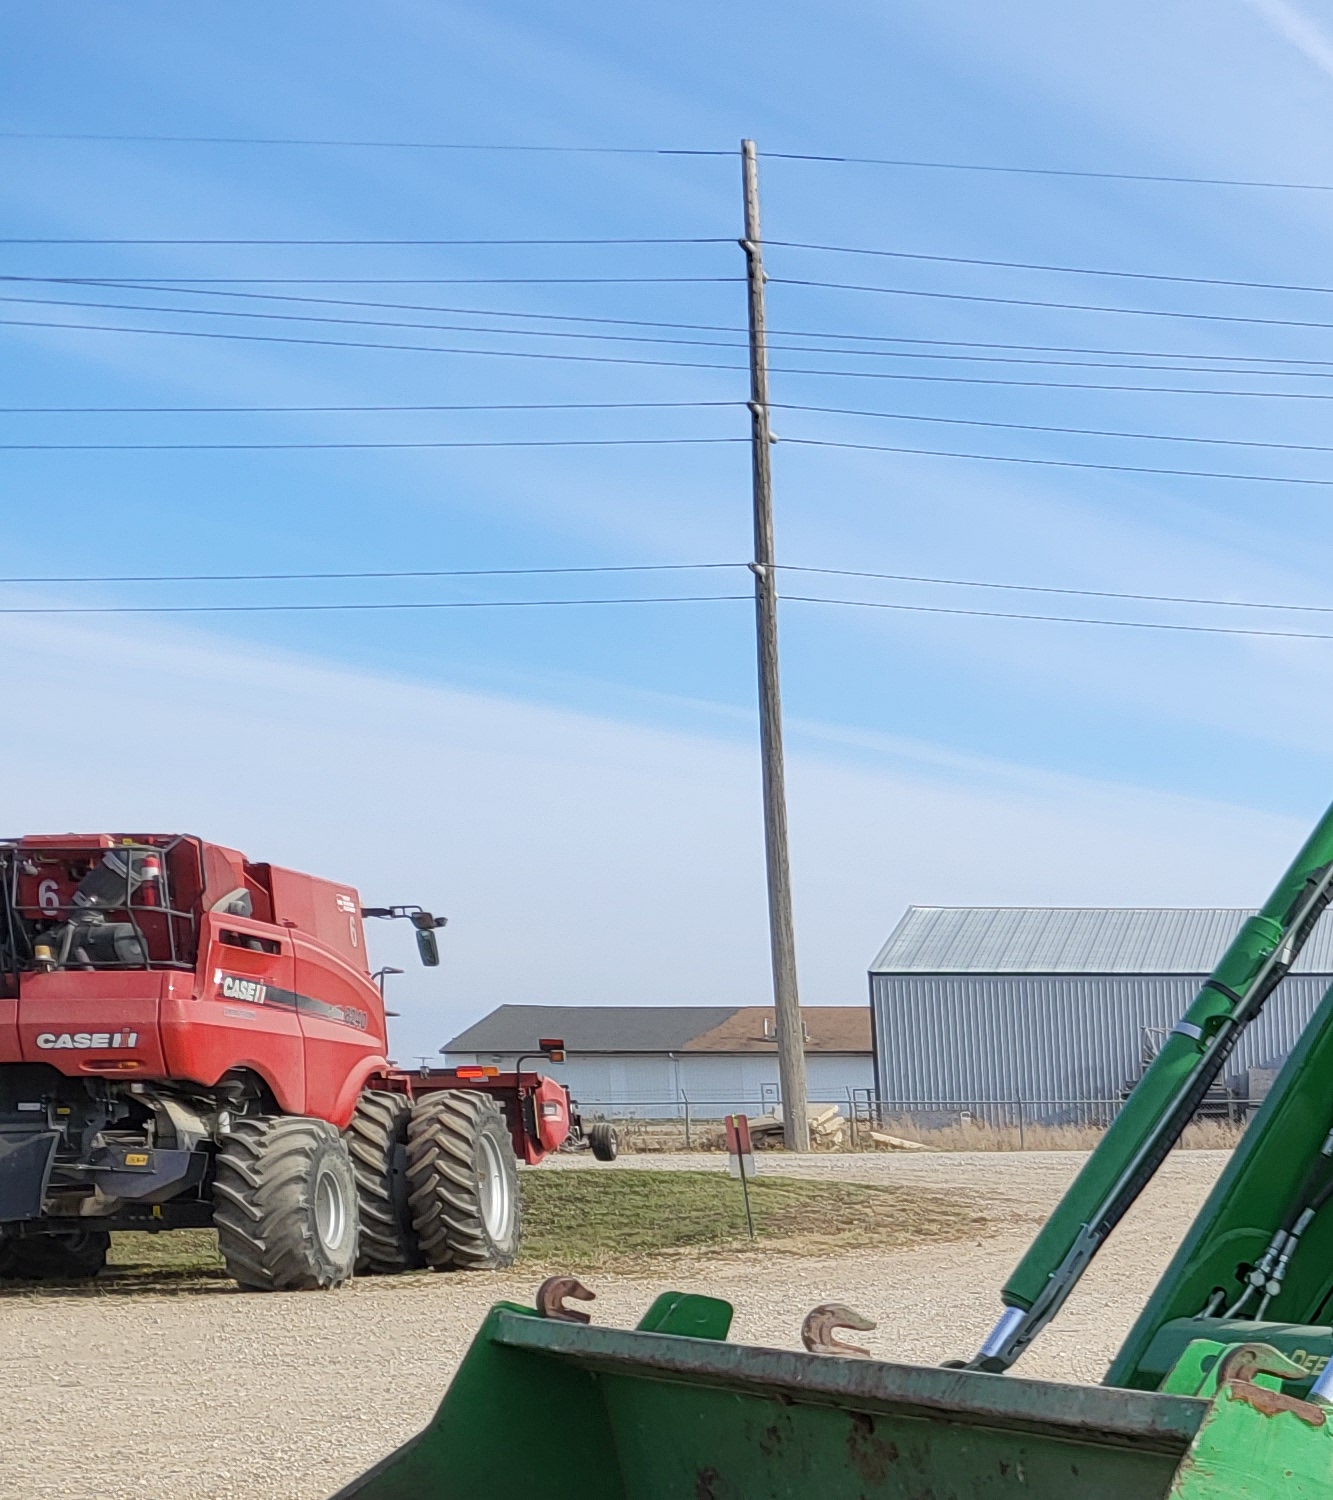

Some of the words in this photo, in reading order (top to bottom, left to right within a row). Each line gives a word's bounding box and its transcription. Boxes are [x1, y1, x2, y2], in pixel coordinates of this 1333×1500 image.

[38, 879, 60, 917] 6
[348, 916, 358, 948] 6
[222, 977, 257, 1001] CASE
[36, 1033, 110, 1048] CASE
[1291, 1349, 1331, 1375] DEE
